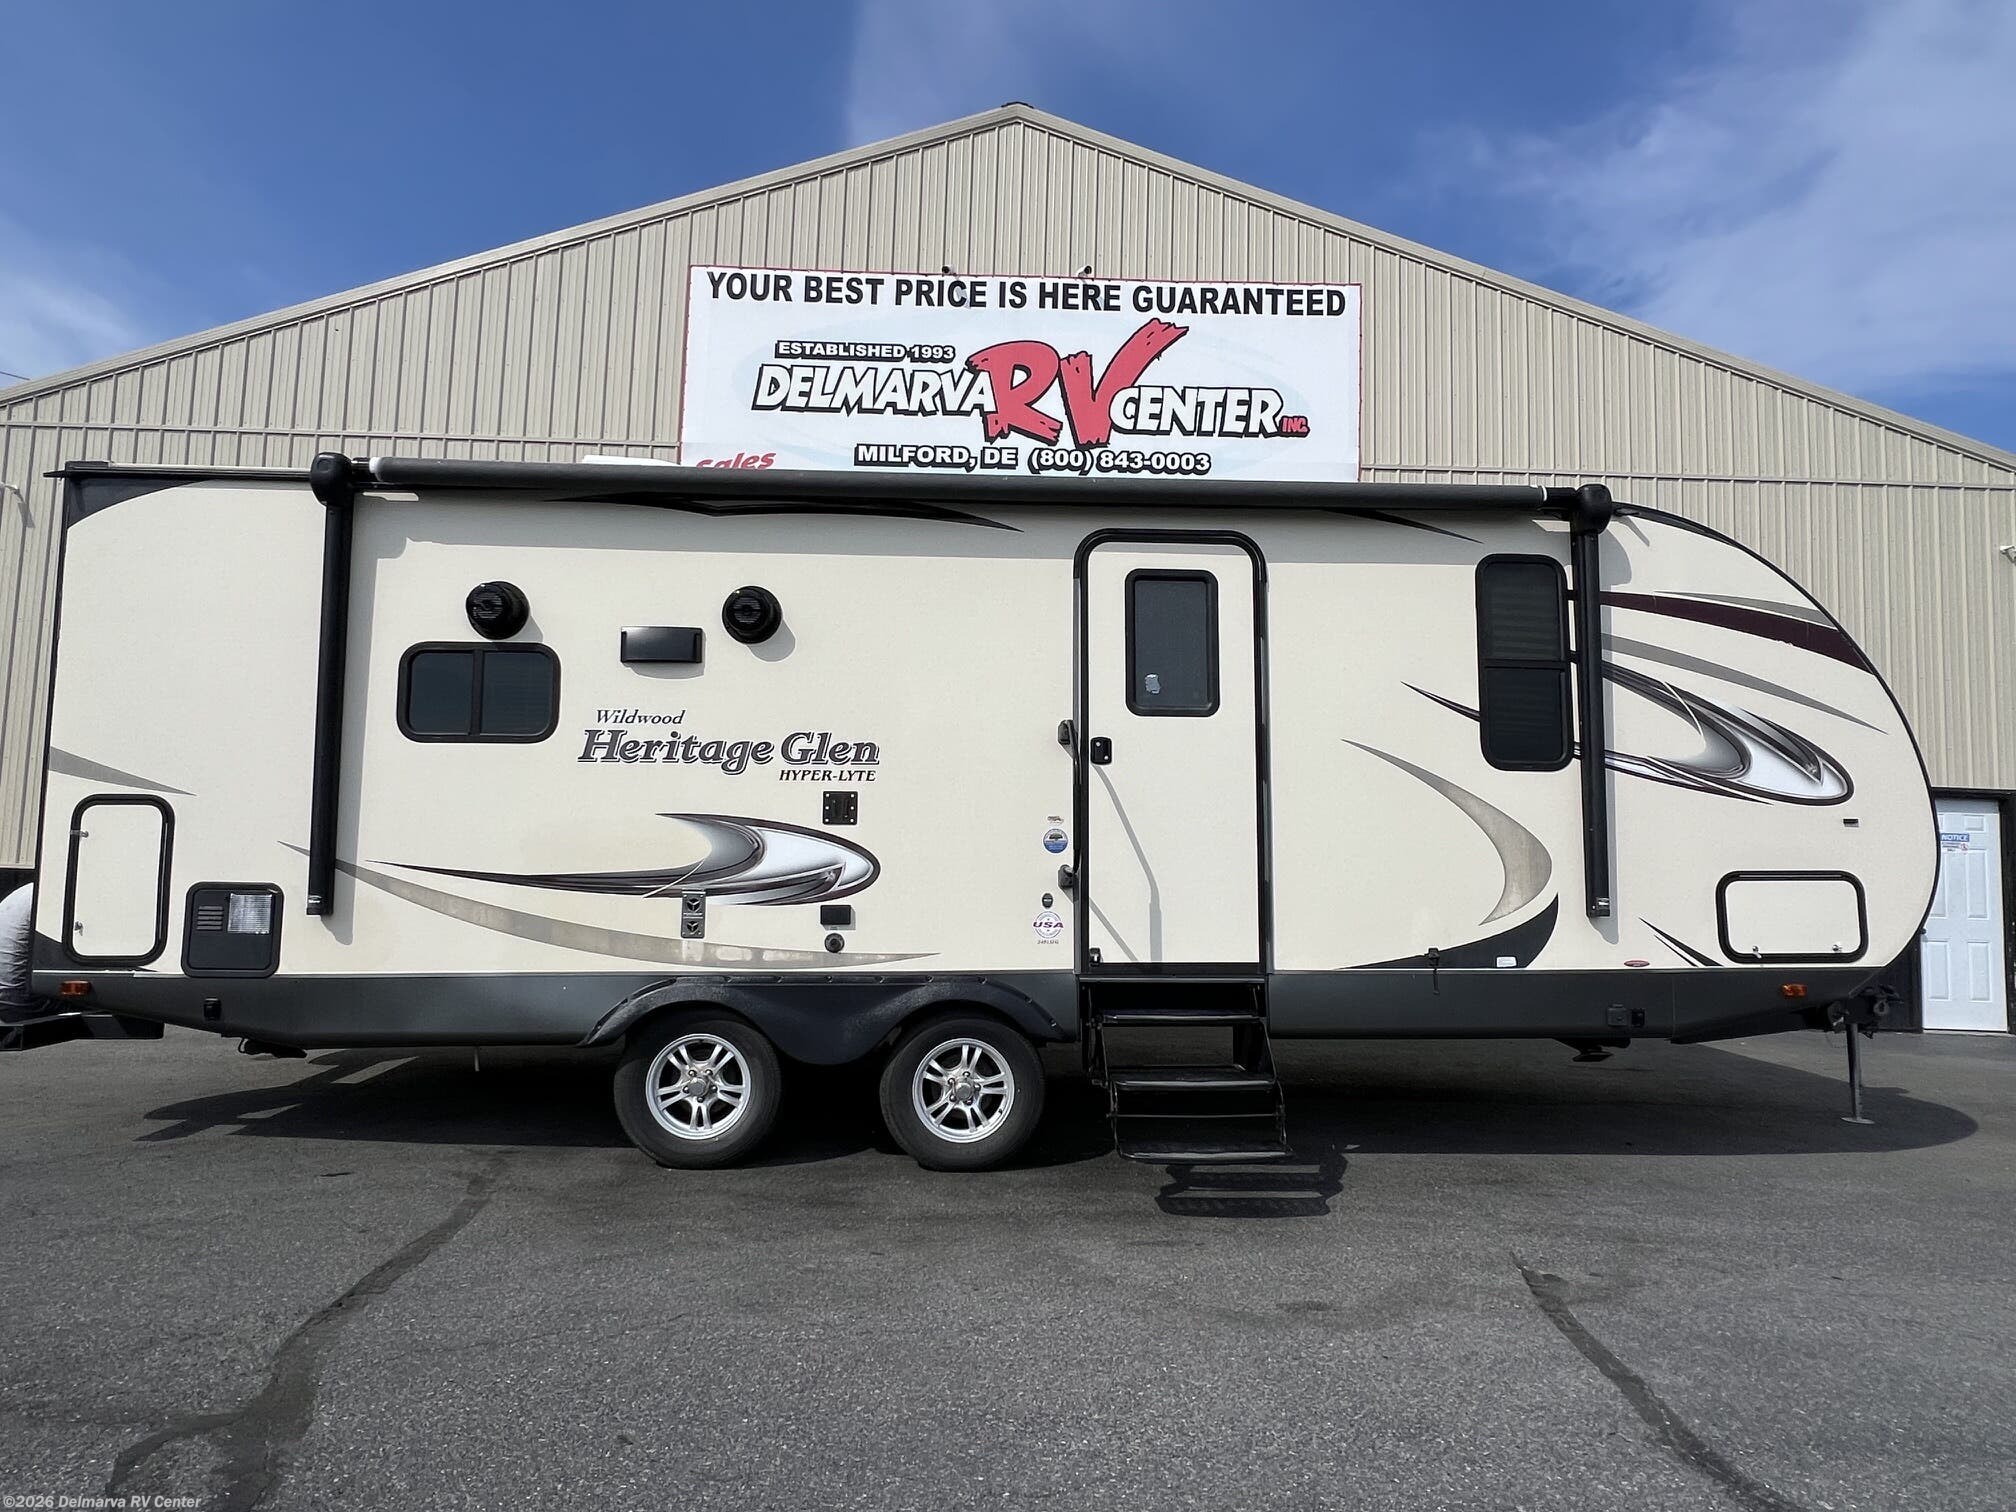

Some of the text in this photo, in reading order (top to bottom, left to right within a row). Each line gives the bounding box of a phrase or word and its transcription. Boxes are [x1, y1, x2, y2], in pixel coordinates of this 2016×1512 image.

[707, 271, 1346, 316] YOUR BEST PRICE IS HERE GUARANTEED
[776, 341, 956, 361] ESTABLISHED 1993
[752, 363, 998, 417] DELMARVA
[966, 317, 1189, 448] RV
[1109, 385, 1285, 437] CENTER
[855, 444, 1212, 474] MILFORD, DE (800) 843-0003
[596, 709, 686, 725] Wildwood
[577, 729, 881, 776] Heritage Glen
[778, 769, 877, 783] HYPER-LYTE
[1033, 921, 1064, 929] USA
